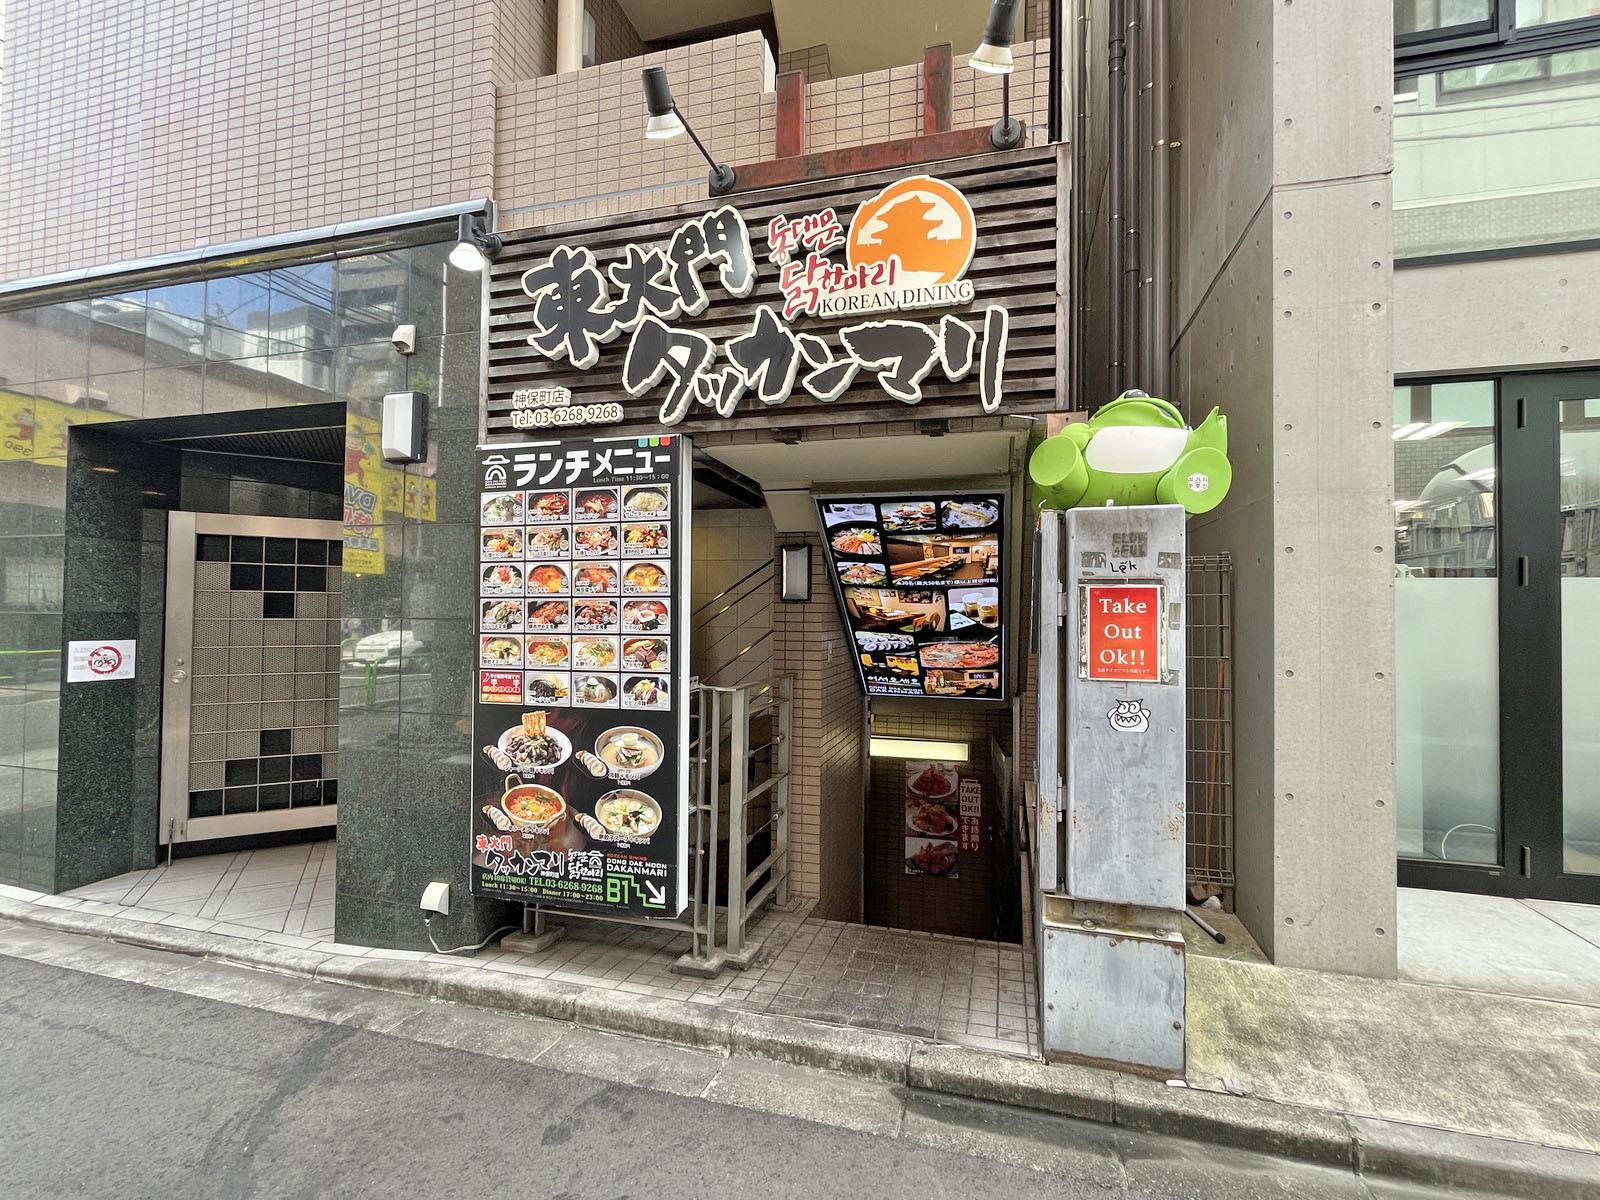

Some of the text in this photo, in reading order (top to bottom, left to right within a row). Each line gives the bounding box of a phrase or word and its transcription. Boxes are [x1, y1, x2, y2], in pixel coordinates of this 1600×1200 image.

[769, 209, 846, 263] 동대문
[523, 208, 755, 368] 東大門
[781, 254, 896, 319] 닭한마리
[822, 282, 972, 313] KOREAN DINING
[625, 306, 1007, 424] タッカンマリ
[514, 389, 565, 407] 神保町店
[512, 413, 532, 426] Tel:
[513, 449, 671, 487] ランチメニュー
[1099, 598, 1147, 614] Take
[1104, 623, 1142, 639] Out
[1099, 649, 1145, 666] Ok!!
[961, 785, 980, 794] TAKE
[961, 795, 979, 803] OUT
[961, 805, 979, 813] OK!!
[476, 834, 512, 853] 東大門
[485, 849, 564, 876] タッカンマリ
[607, 864, 667, 877] DAKANMARI
[542, 888, 561, 896] Dinner
[607, 878, 629, 904] B1
